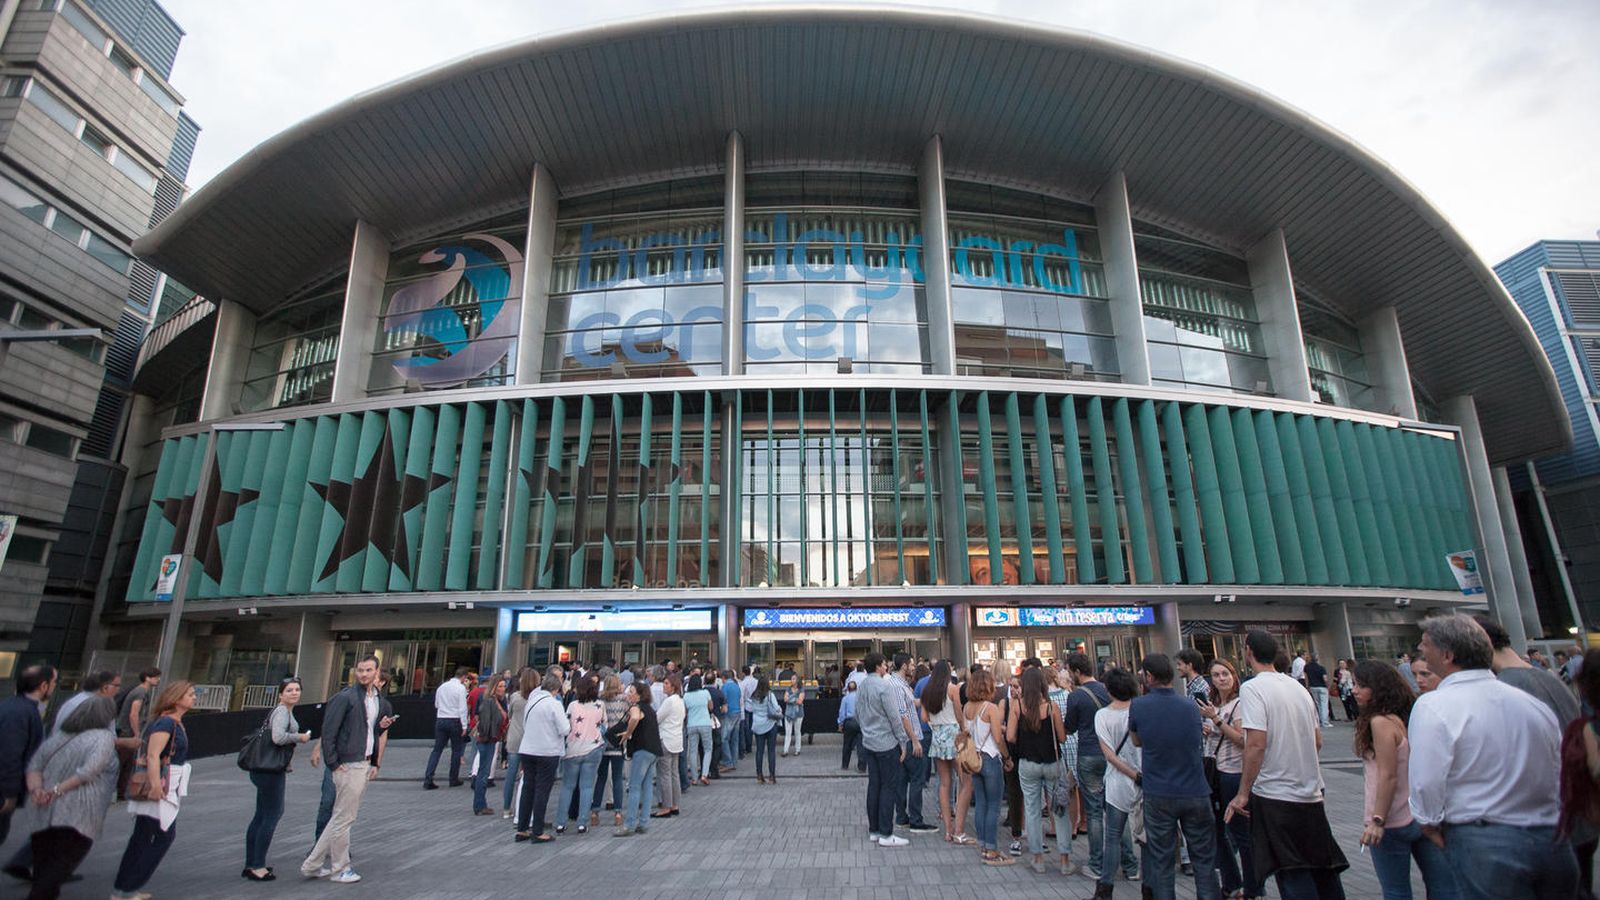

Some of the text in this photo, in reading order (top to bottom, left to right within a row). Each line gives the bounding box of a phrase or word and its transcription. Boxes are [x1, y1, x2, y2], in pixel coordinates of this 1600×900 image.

[571, 291, 873, 367] center
[779, 613, 839, 623] BIENVENIDOS
[840, 612, 847, 622] A
[847, 612, 910, 623] OKTOBERFEST
[1056, 609, 1074, 623] sin
[1076, 611, 1114, 623] reserva
